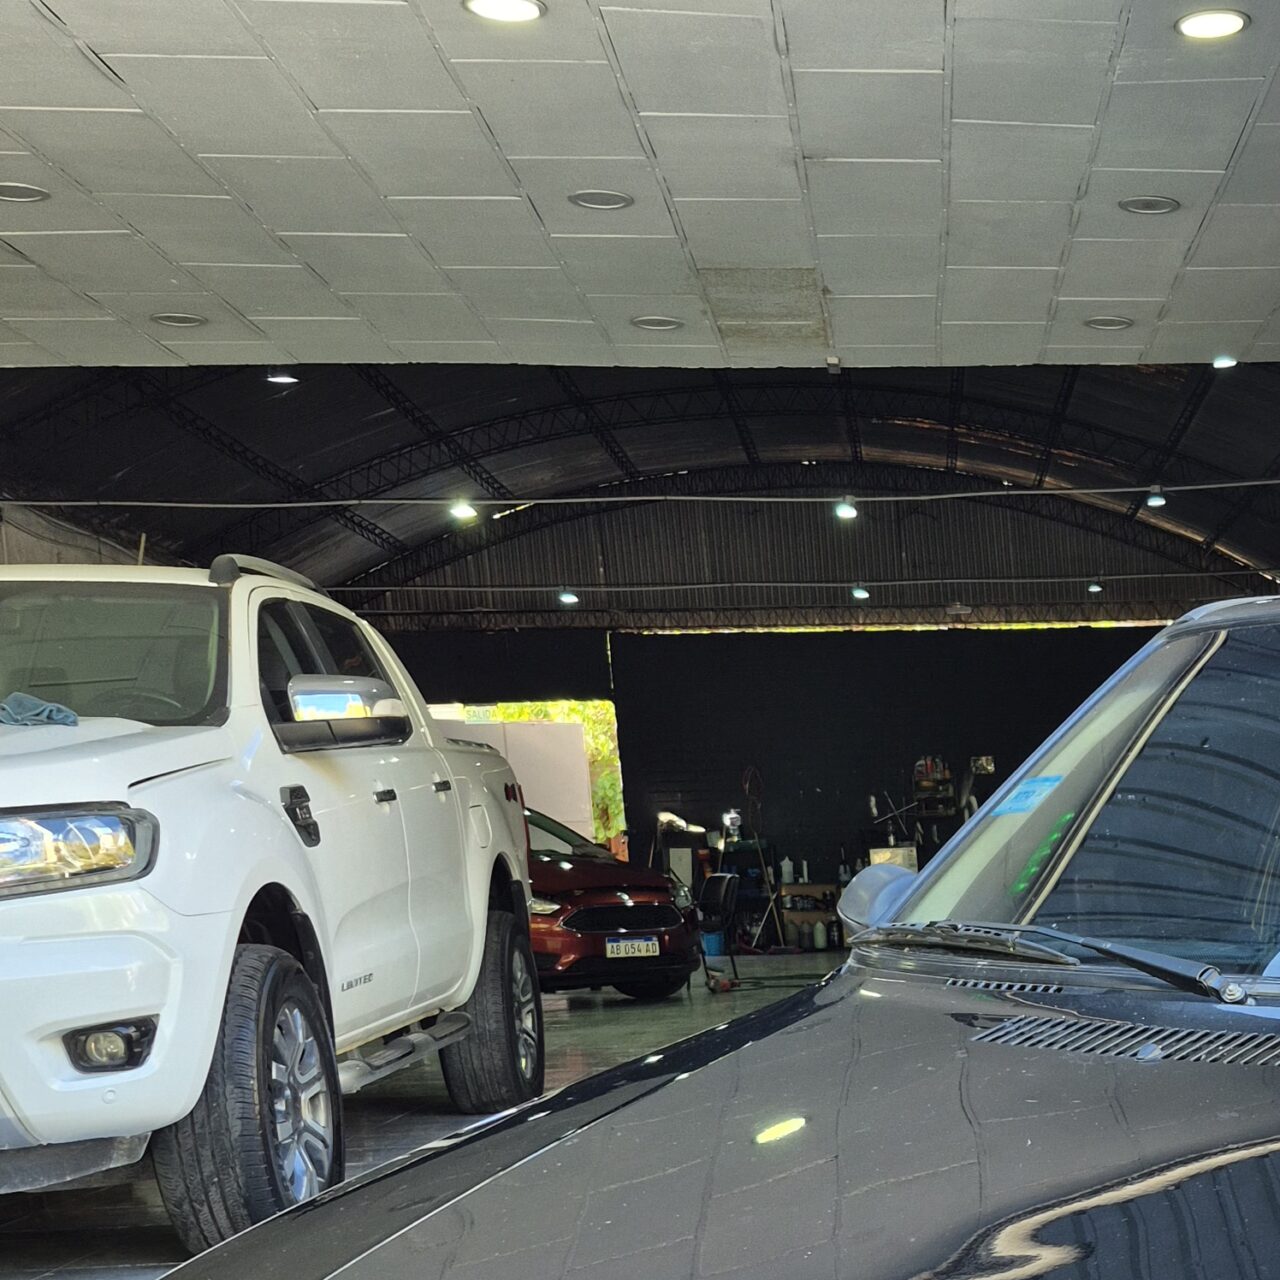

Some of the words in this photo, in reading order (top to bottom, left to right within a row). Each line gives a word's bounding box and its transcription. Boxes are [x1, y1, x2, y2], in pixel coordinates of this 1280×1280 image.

[610, 944, 621, 955] AB
[625, 943, 642, 955] 054
[646, 942, 657, 954] AD
